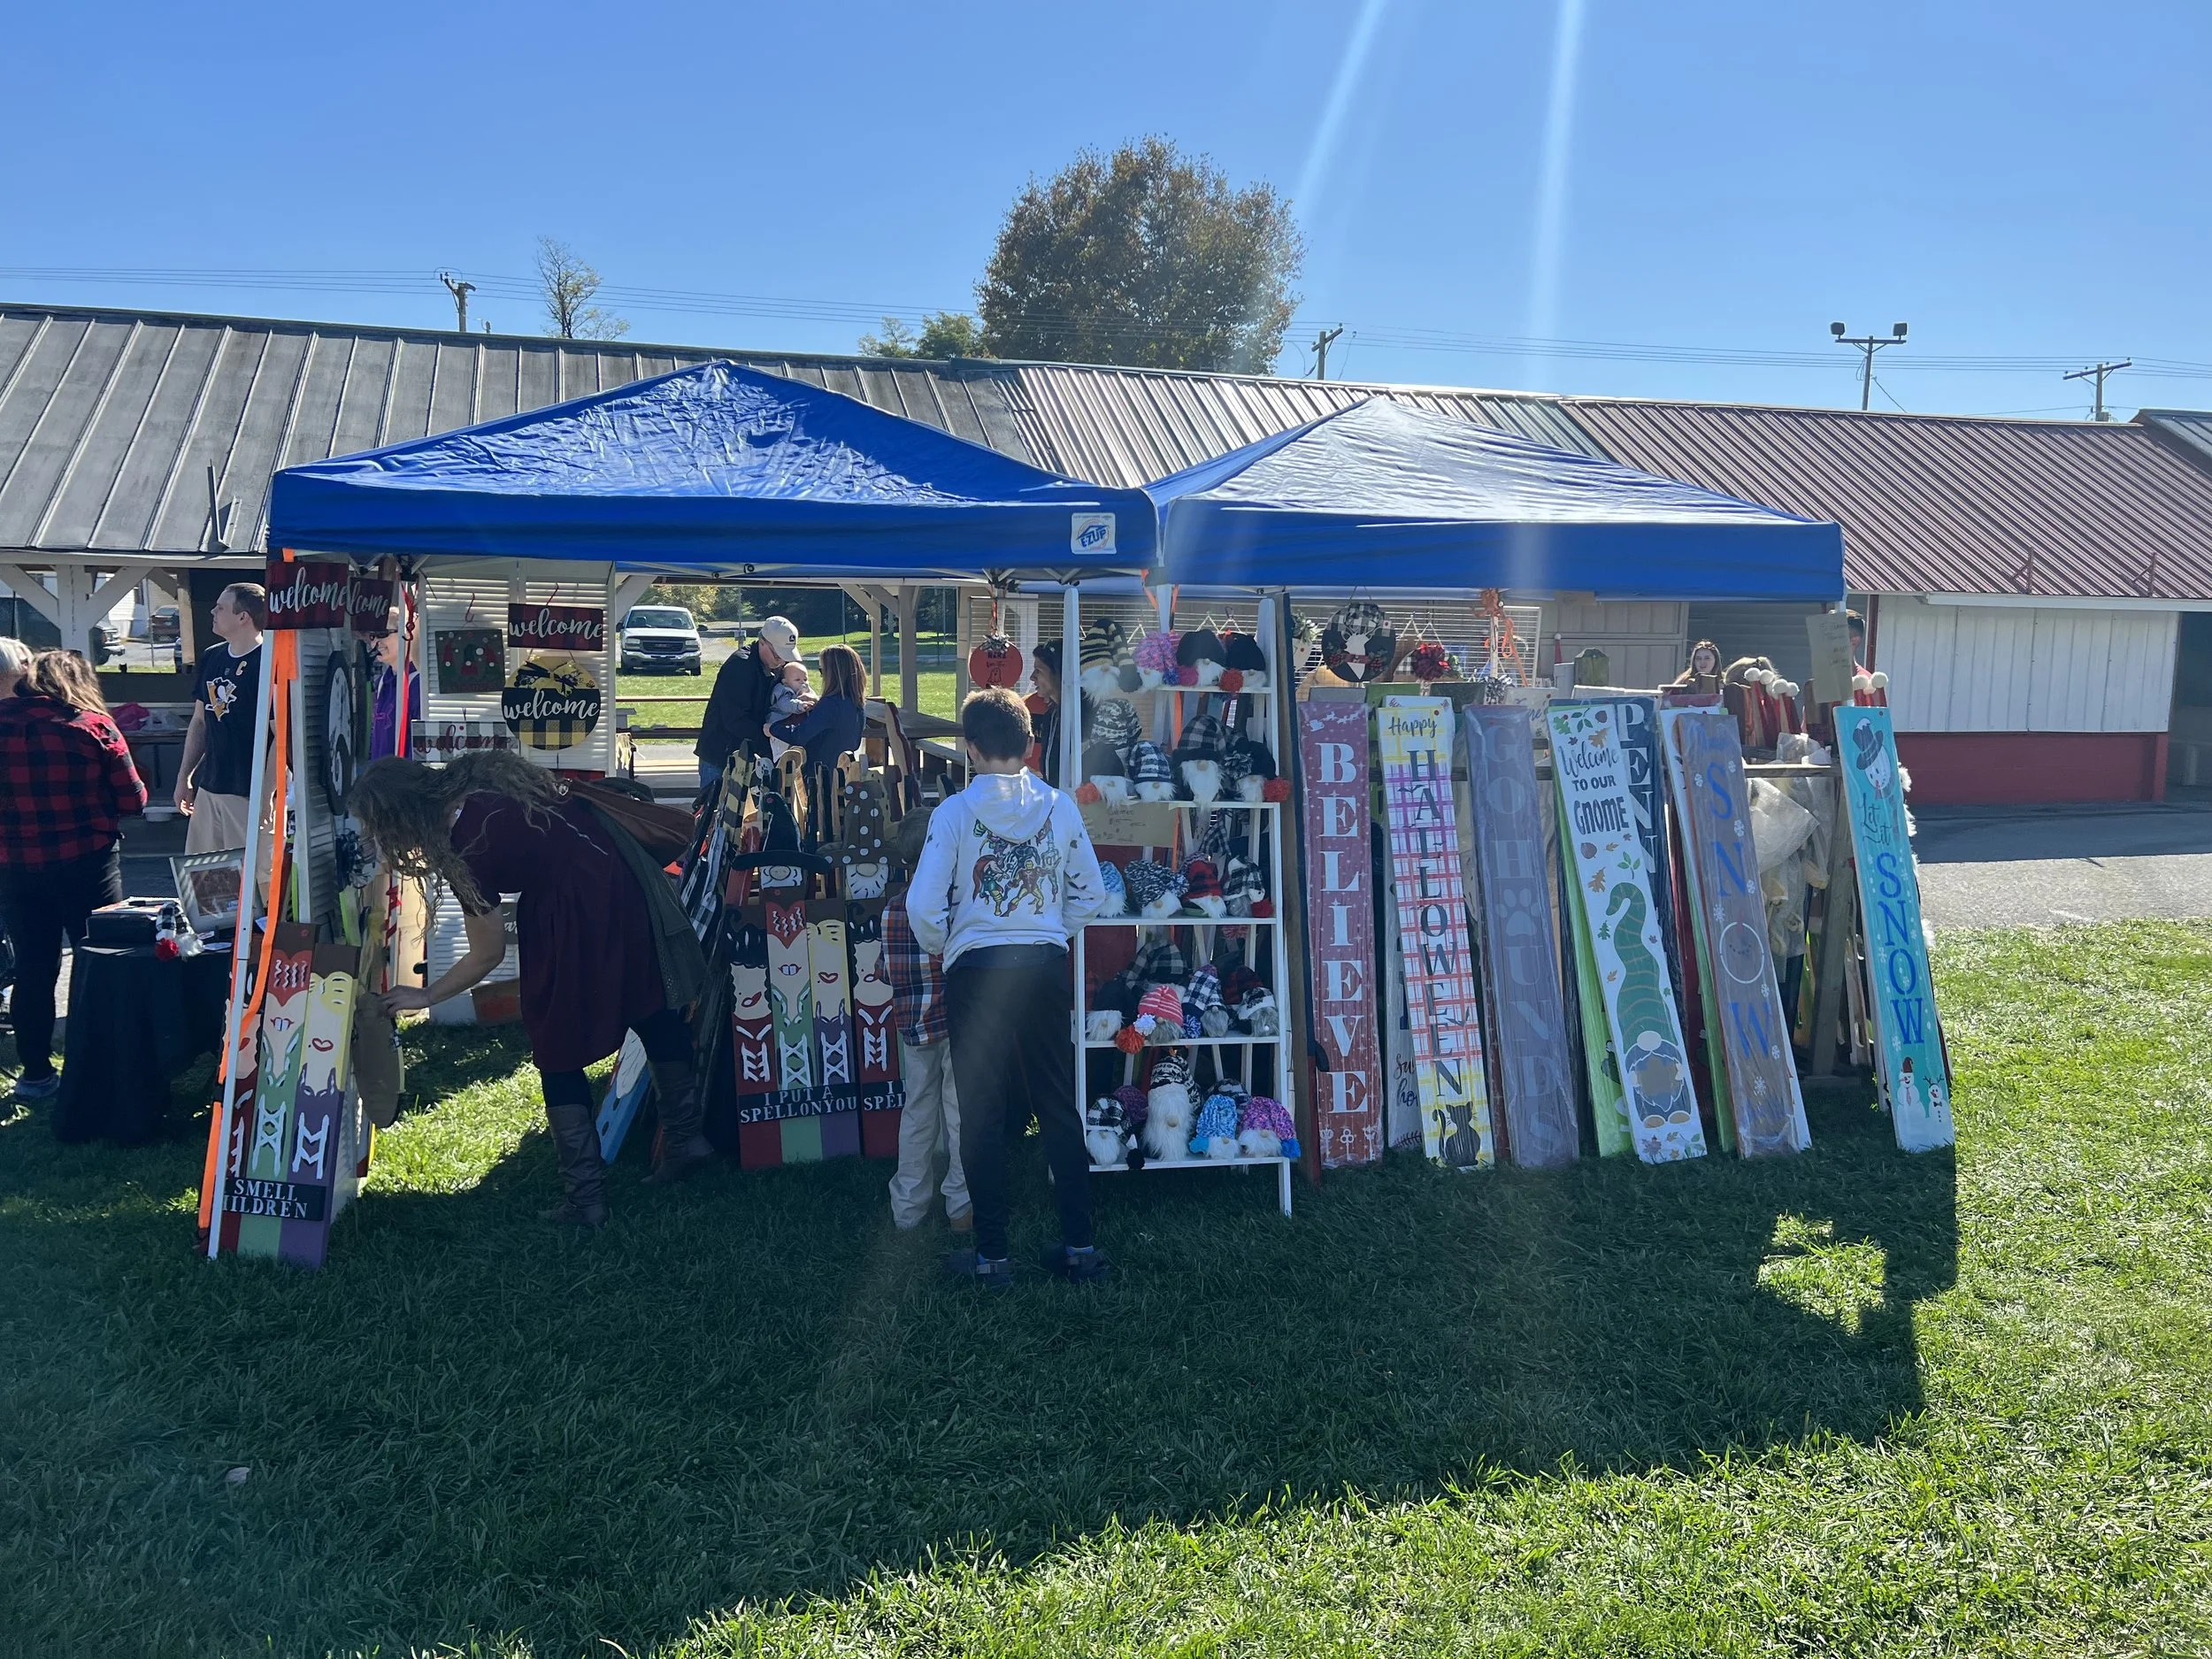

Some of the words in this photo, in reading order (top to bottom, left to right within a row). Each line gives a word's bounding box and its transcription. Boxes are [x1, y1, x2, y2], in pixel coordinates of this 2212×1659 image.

[269, 566, 347, 614] welcome
[509, 608, 603, 641] welcome
[235, 660, 248, 676] C
[503, 689, 600, 720] welcome
[1387, 716, 1438, 739] Happy
[1484, 726, 1526, 814] GO
[1557, 741, 1619, 778] Welcome
[1571, 779, 1589, 792] TO
[1590, 774, 1617, 790] OUR
[1407, 749, 1463, 1097] HALLOWEEN
[1706, 762, 1771, 1058] SNOW
[1315, 742, 1368, 1113] BELIEVE
[1876, 852, 1924, 1046] SNOW
[764, 1092, 771, 1106] I
[779, 1087, 814, 1104] PUT
[821, 1086, 834, 1100] A
[887, 1080, 894, 1094] I
[234, 1179, 298, 1202] SMELL
